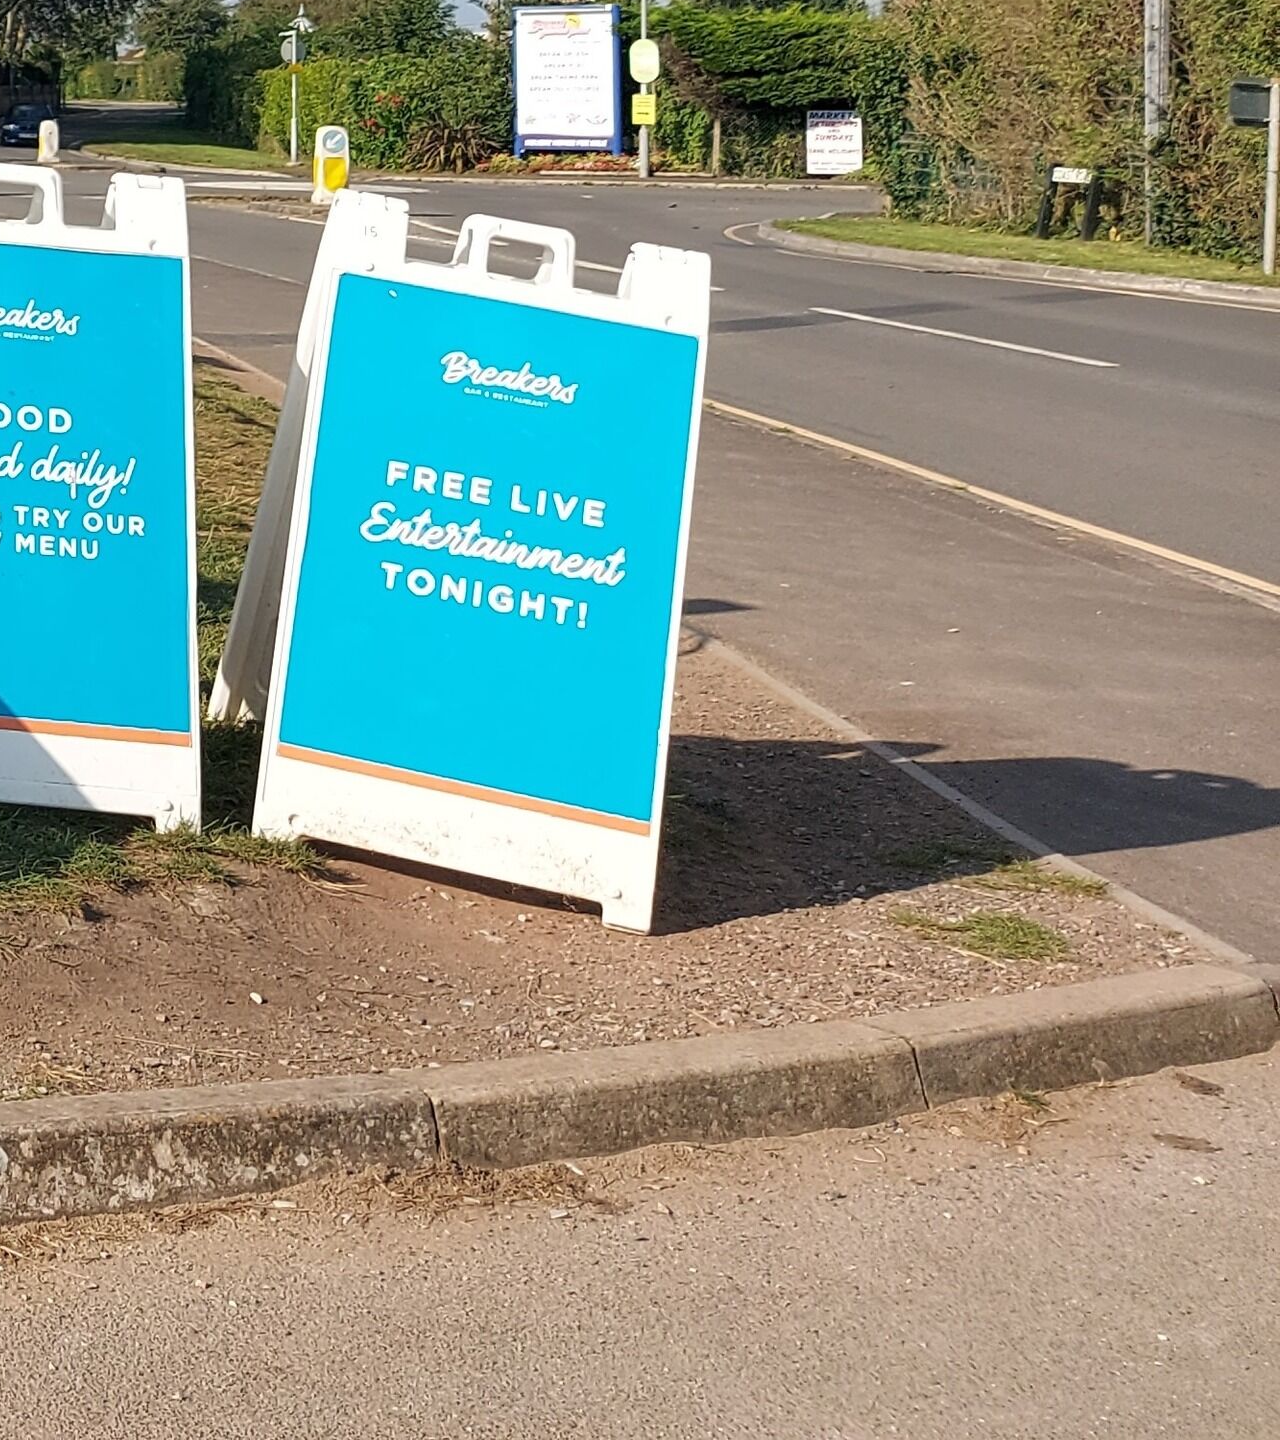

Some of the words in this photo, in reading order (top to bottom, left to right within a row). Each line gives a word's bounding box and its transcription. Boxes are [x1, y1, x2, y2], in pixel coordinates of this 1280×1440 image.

[440, 351, 579, 404] Breakers
[30, 444, 137, 509] daily!
[385, 460, 493, 506] FREE
[510, 484, 608, 528] LIVE
[13, 505, 71, 530] TRY
[82, 511, 146, 537] OUR
[14, 534, 100, 561] MENU
[359, 501, 627, 587] Entertainment
[380, 561, 589, 630] TONIGHT!
